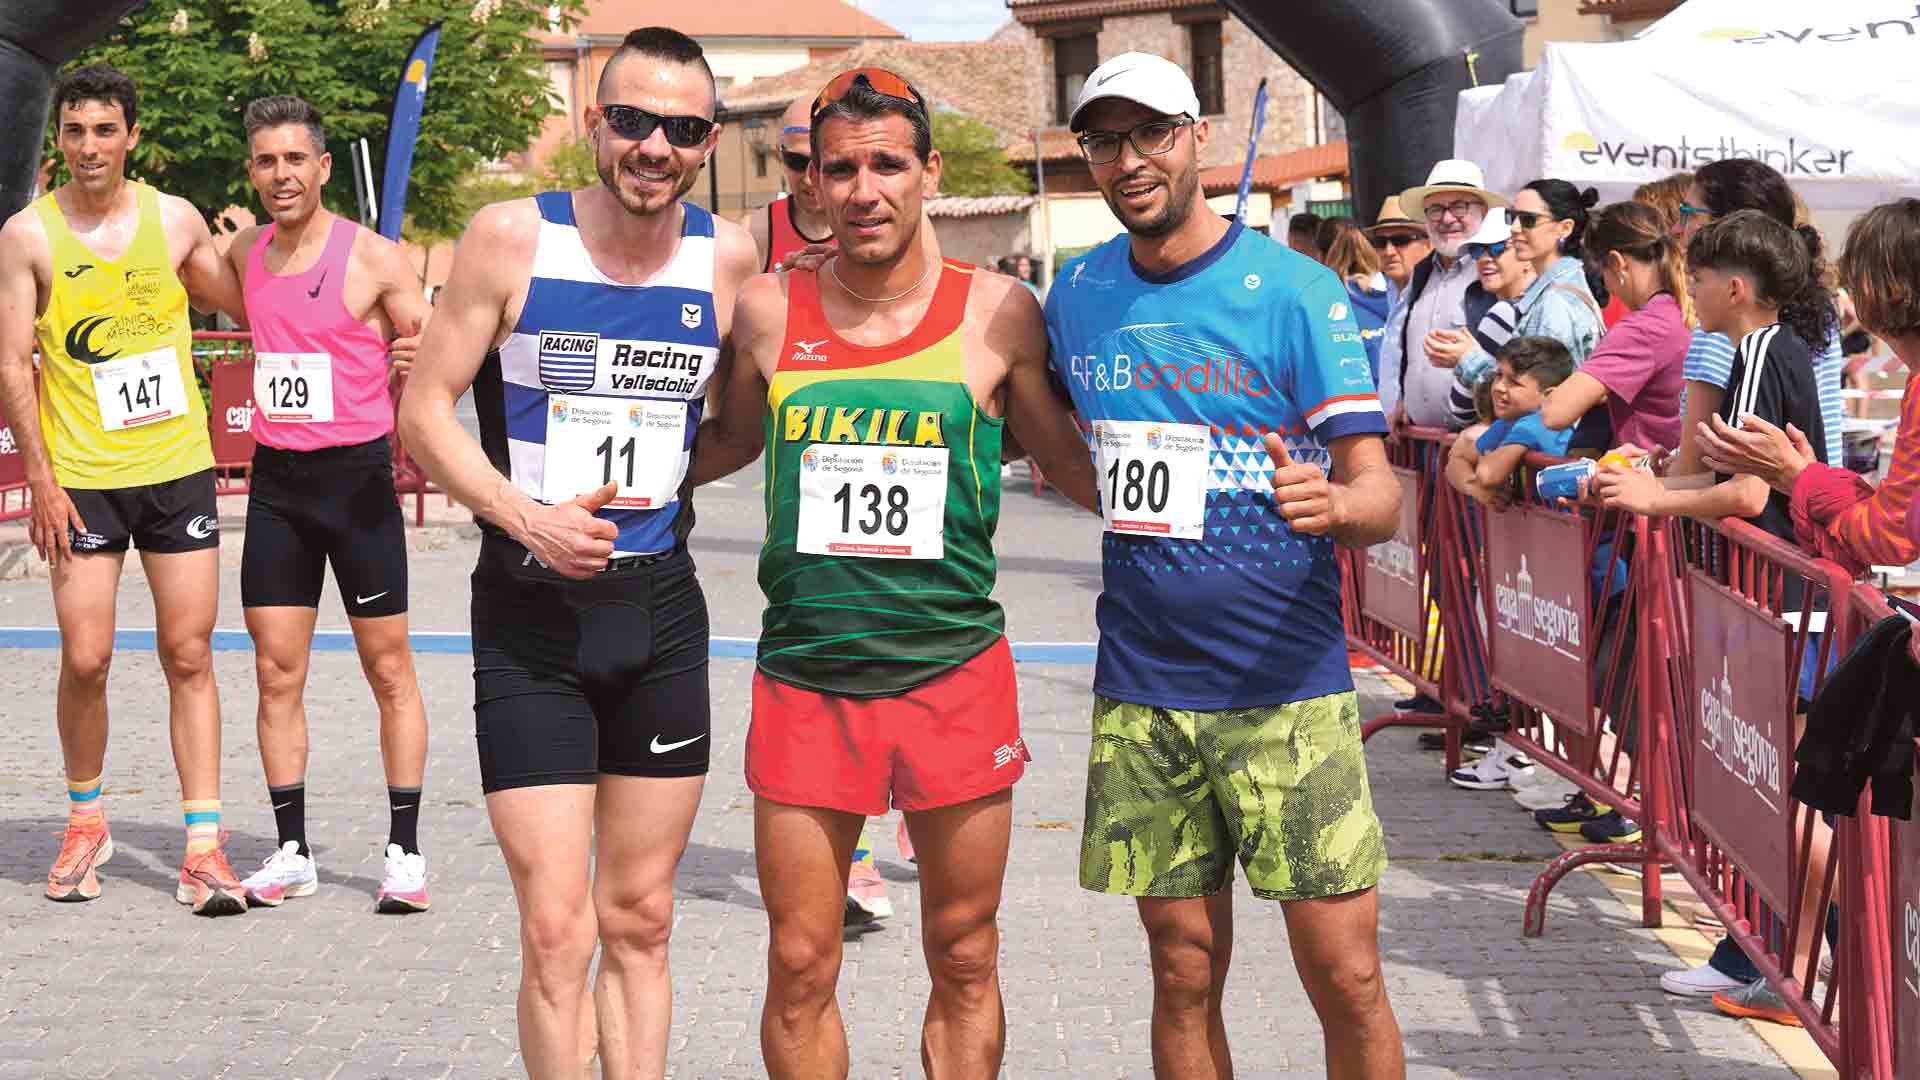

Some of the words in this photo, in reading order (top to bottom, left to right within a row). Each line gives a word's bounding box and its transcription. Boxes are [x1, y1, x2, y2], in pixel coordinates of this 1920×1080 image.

[1578, 134, 1854, 174] eventsthinker
[543, 336, 595, 352] RACING
[611, 344, 704, 376] Racing
[119, 375, 161, 412] 147
[268, 376, 309, 408] 129
[611, 374, 698, 394] Valladolid
[226, 399, 256, 432] caj
[784, 405, 946, 446] BIKILA
[596, 436, 635, 487] 11
[1107, 458, 1170, 513] 180
[834, 482, 909, 536] 138
[1534, 594, 1580, 647] segovia
[1733, 715, 1781, 795] segovia
